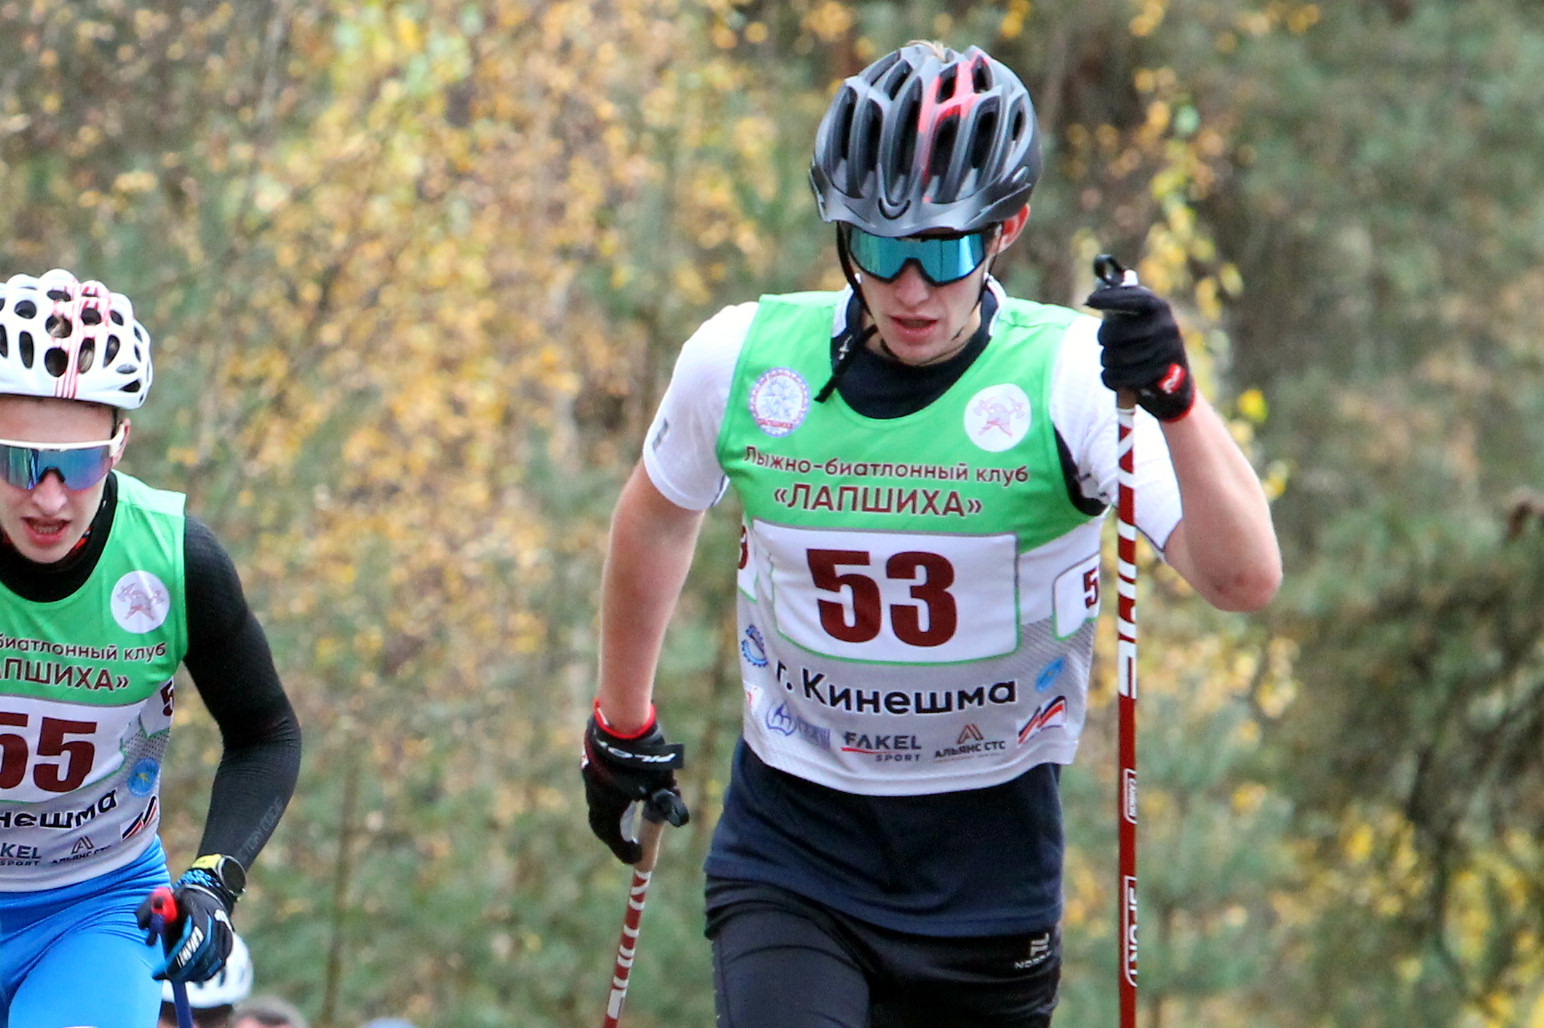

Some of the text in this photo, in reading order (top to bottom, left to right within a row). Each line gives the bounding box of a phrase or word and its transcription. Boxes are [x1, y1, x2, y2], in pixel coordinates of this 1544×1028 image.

[744, 446, 1030, 486] Лыжно-биатлонный клуб
[774, 482, 983, 517] «ЛАПШИХА»
[806, 548, 957, 648] 53
[124, 642, 167, 663] клуб
[775, 659, 1017, 715] г. Кинешма
[843, 731, 922, 750] FAKEL
[984, 741, 1006, 751] СТС
[876, 754, 921, 762] SPORT
